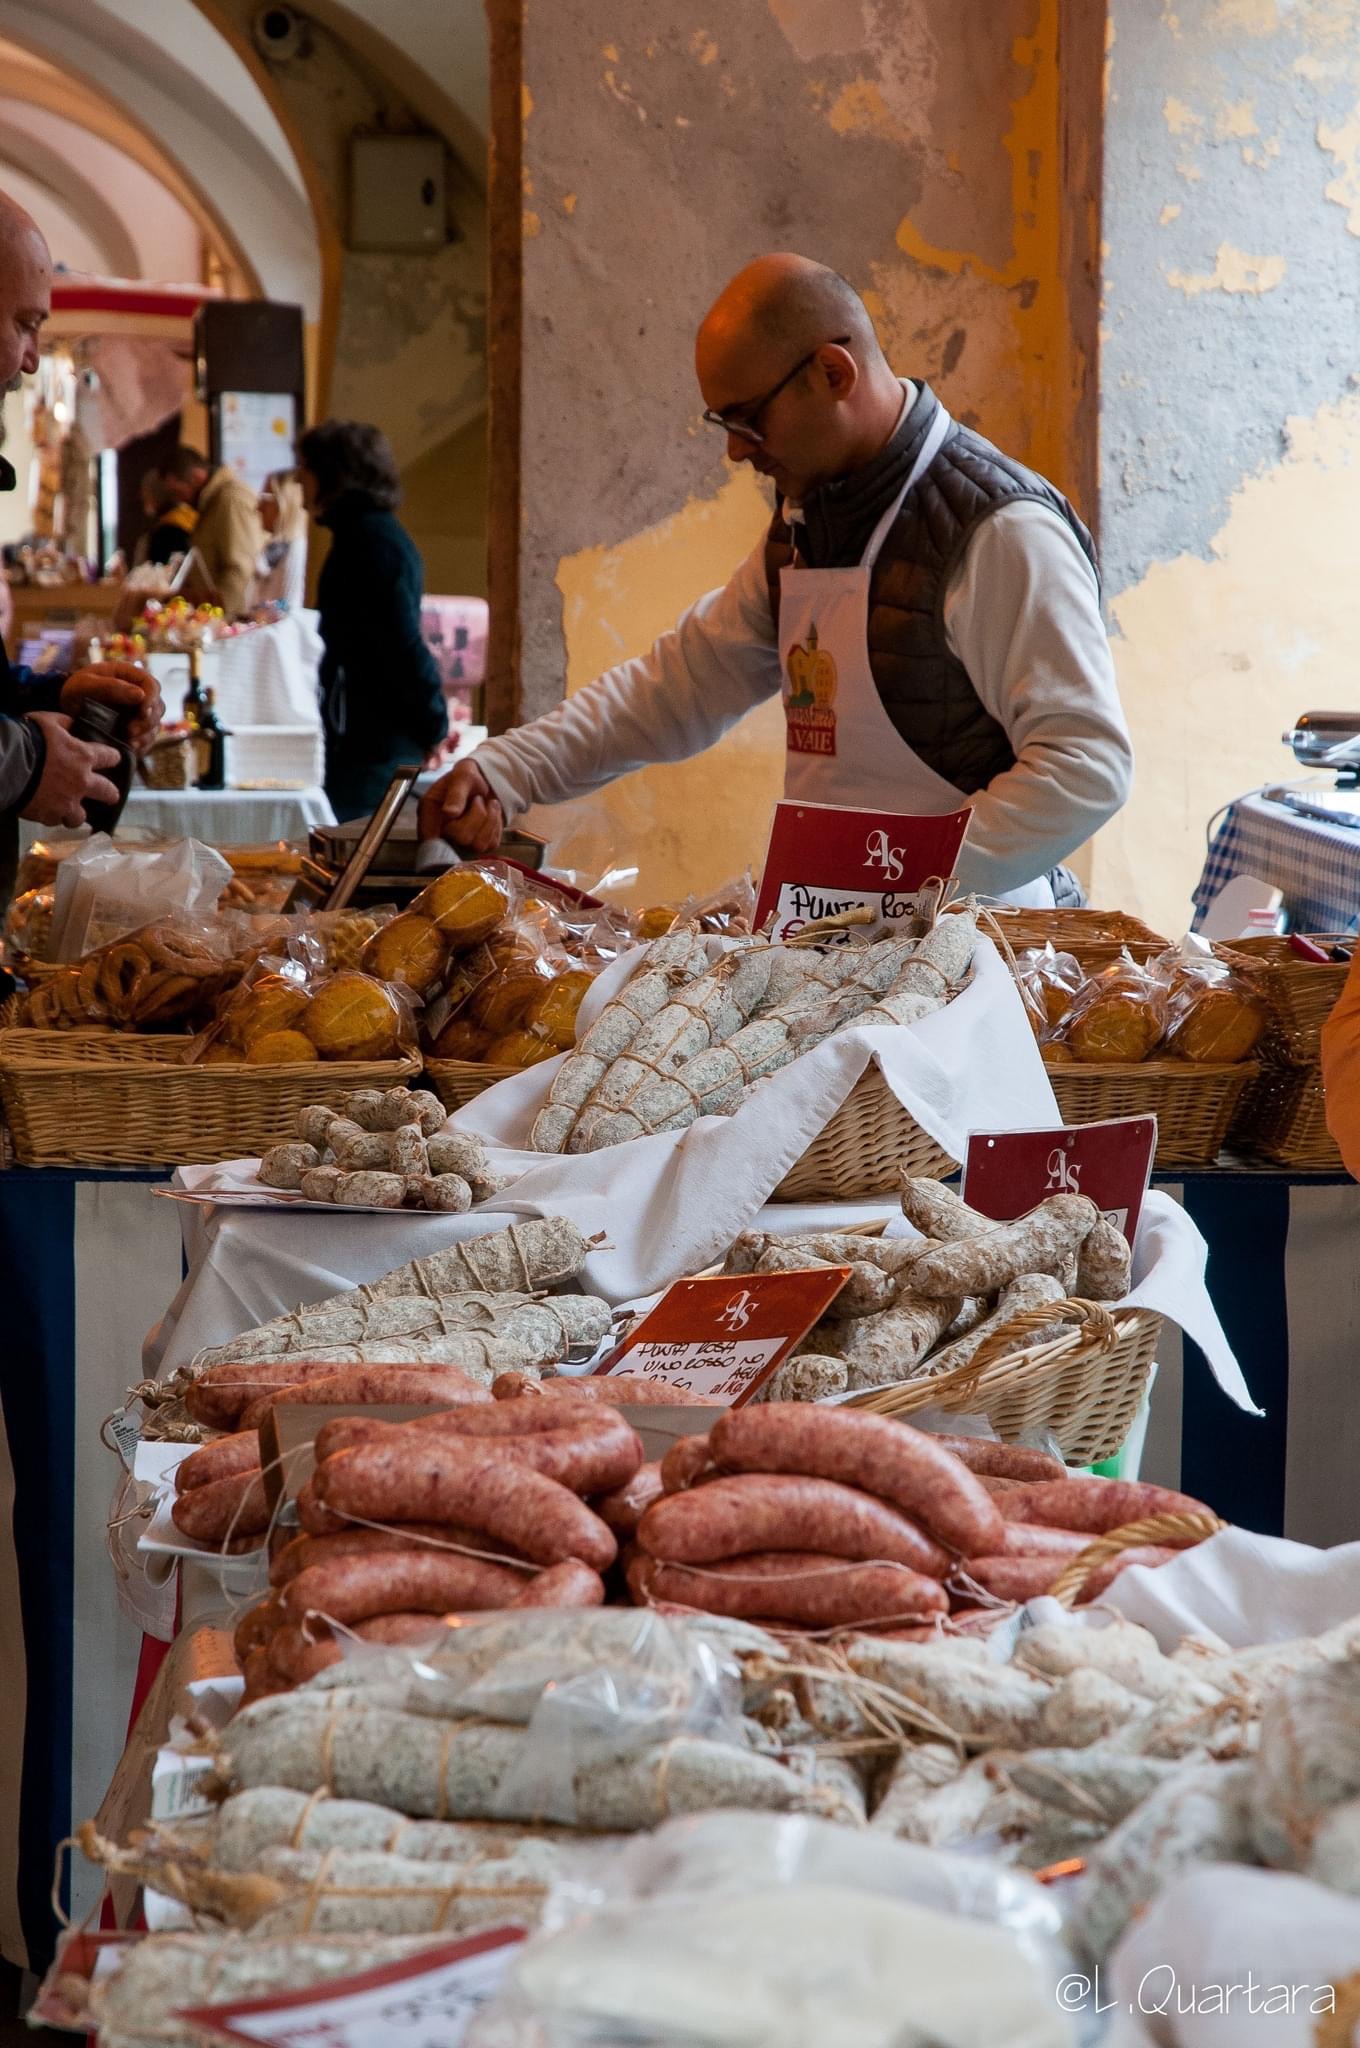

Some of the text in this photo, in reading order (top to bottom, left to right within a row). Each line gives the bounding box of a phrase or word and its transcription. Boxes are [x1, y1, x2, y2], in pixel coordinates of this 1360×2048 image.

[862, 829, 907, 881] AS
[790, 885, 865, 920] PUNT
[683, 1356, 736, 1371] ROSSO
[709, 1381, 726, 1394] al
